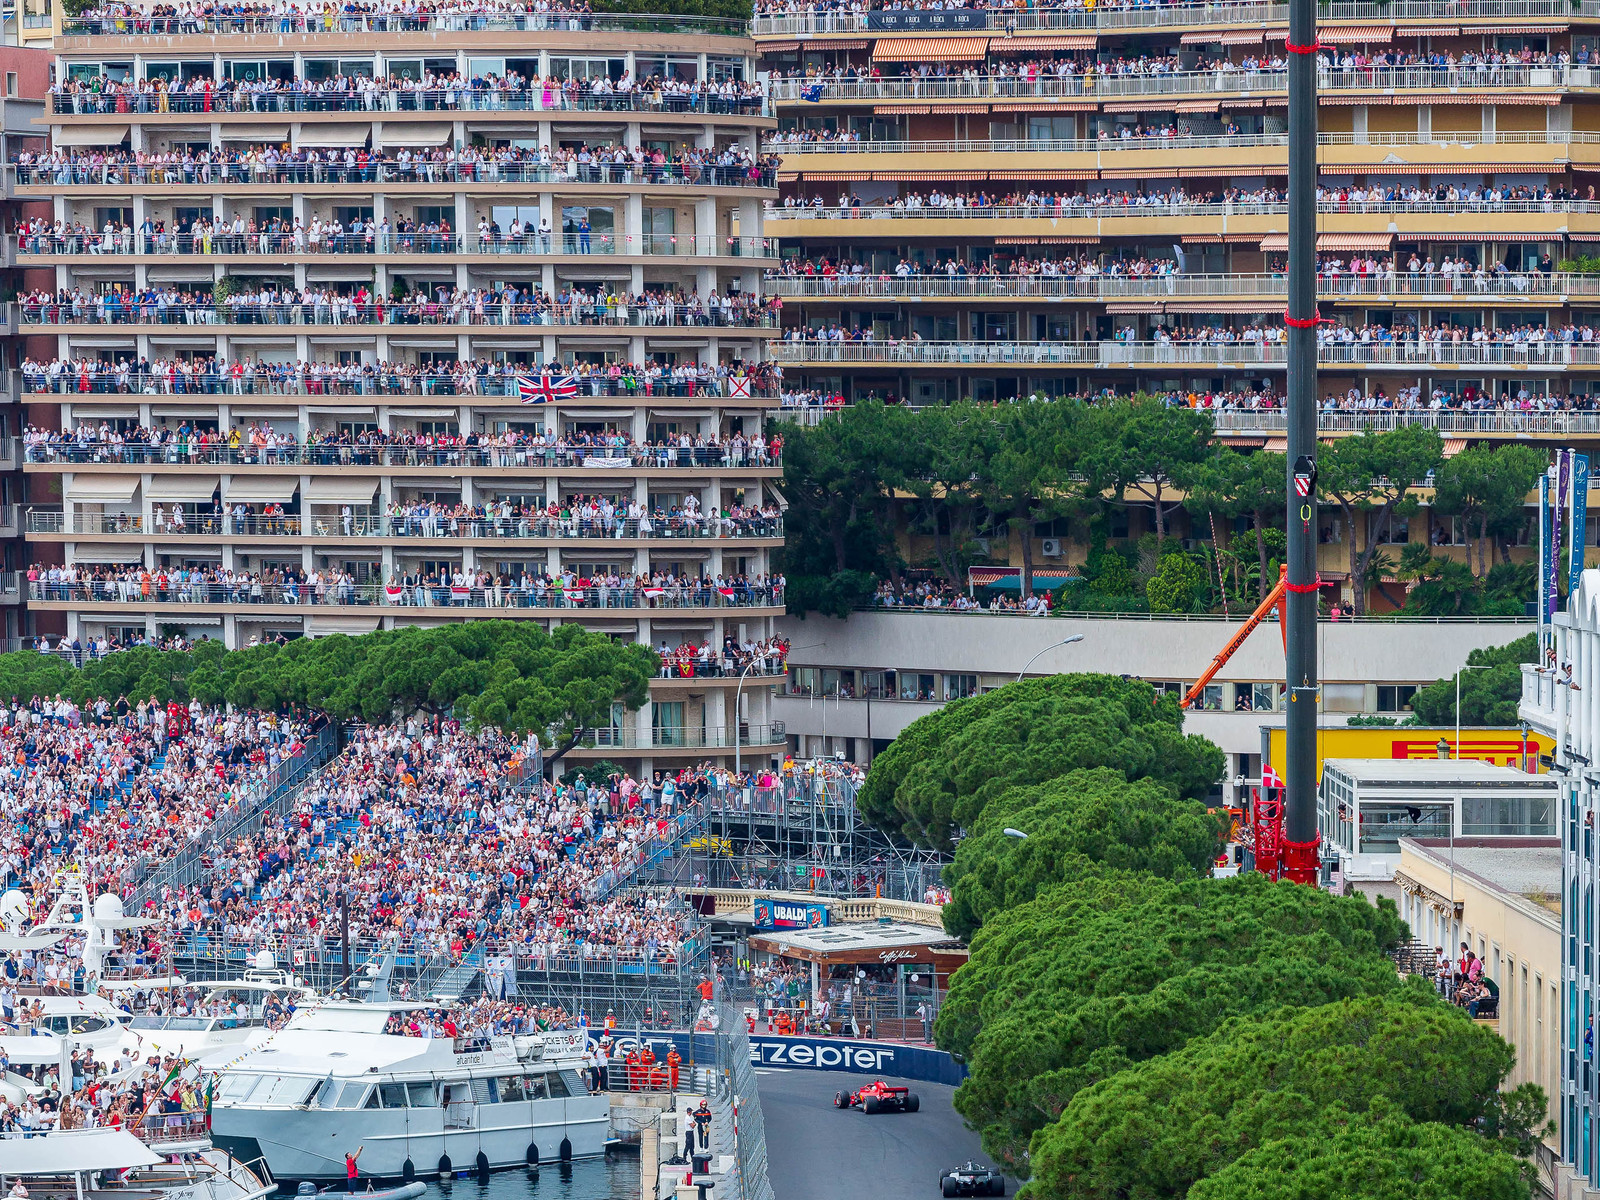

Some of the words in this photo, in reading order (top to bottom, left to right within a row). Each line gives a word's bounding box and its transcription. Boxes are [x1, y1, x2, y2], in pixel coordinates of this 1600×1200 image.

[774, 905, 807, 921] UBALDI
[295, 956, 303, 965] K1
[769, 1043, 894, 1070] zepter
